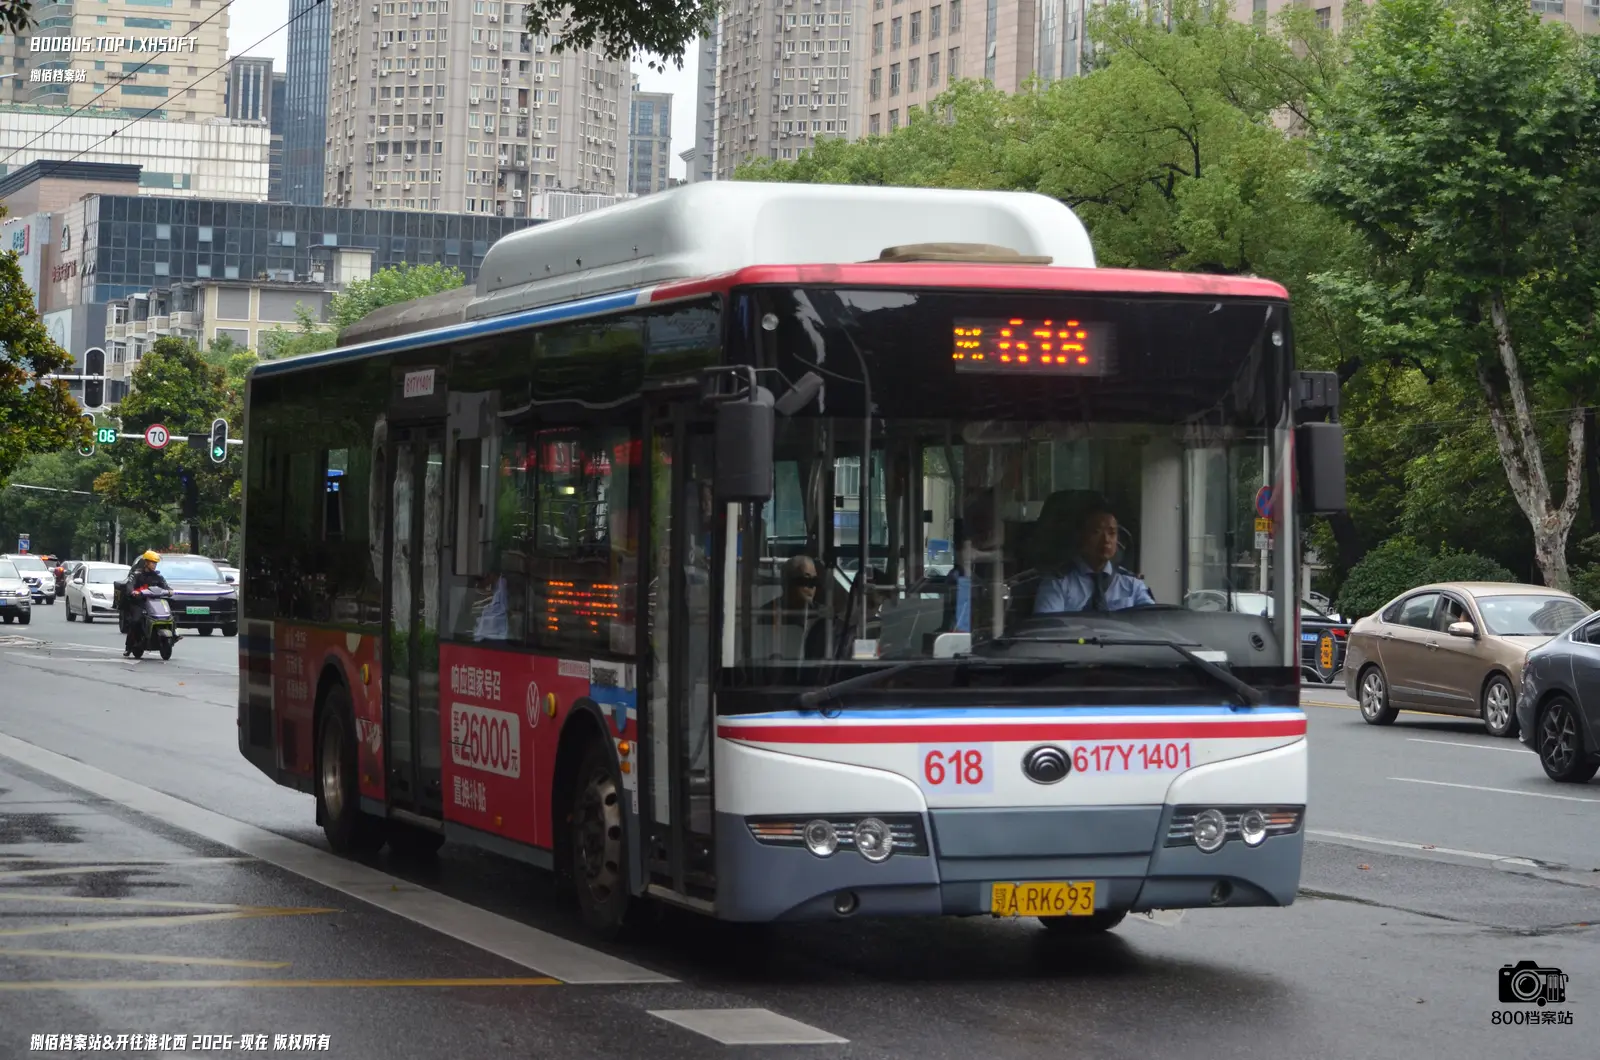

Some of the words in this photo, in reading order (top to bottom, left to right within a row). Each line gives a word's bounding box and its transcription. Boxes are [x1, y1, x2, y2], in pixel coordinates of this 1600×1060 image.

[98, 429, 116, 443] 06
[150, 431, 165, 443] 70
[451, 664, 501, 701] 响应国家号召
[924, 749, 984, 785] 618
[1072, 742, 1192, 773] 617Y1401
[453, 776, 487, 813] 置换补贴
